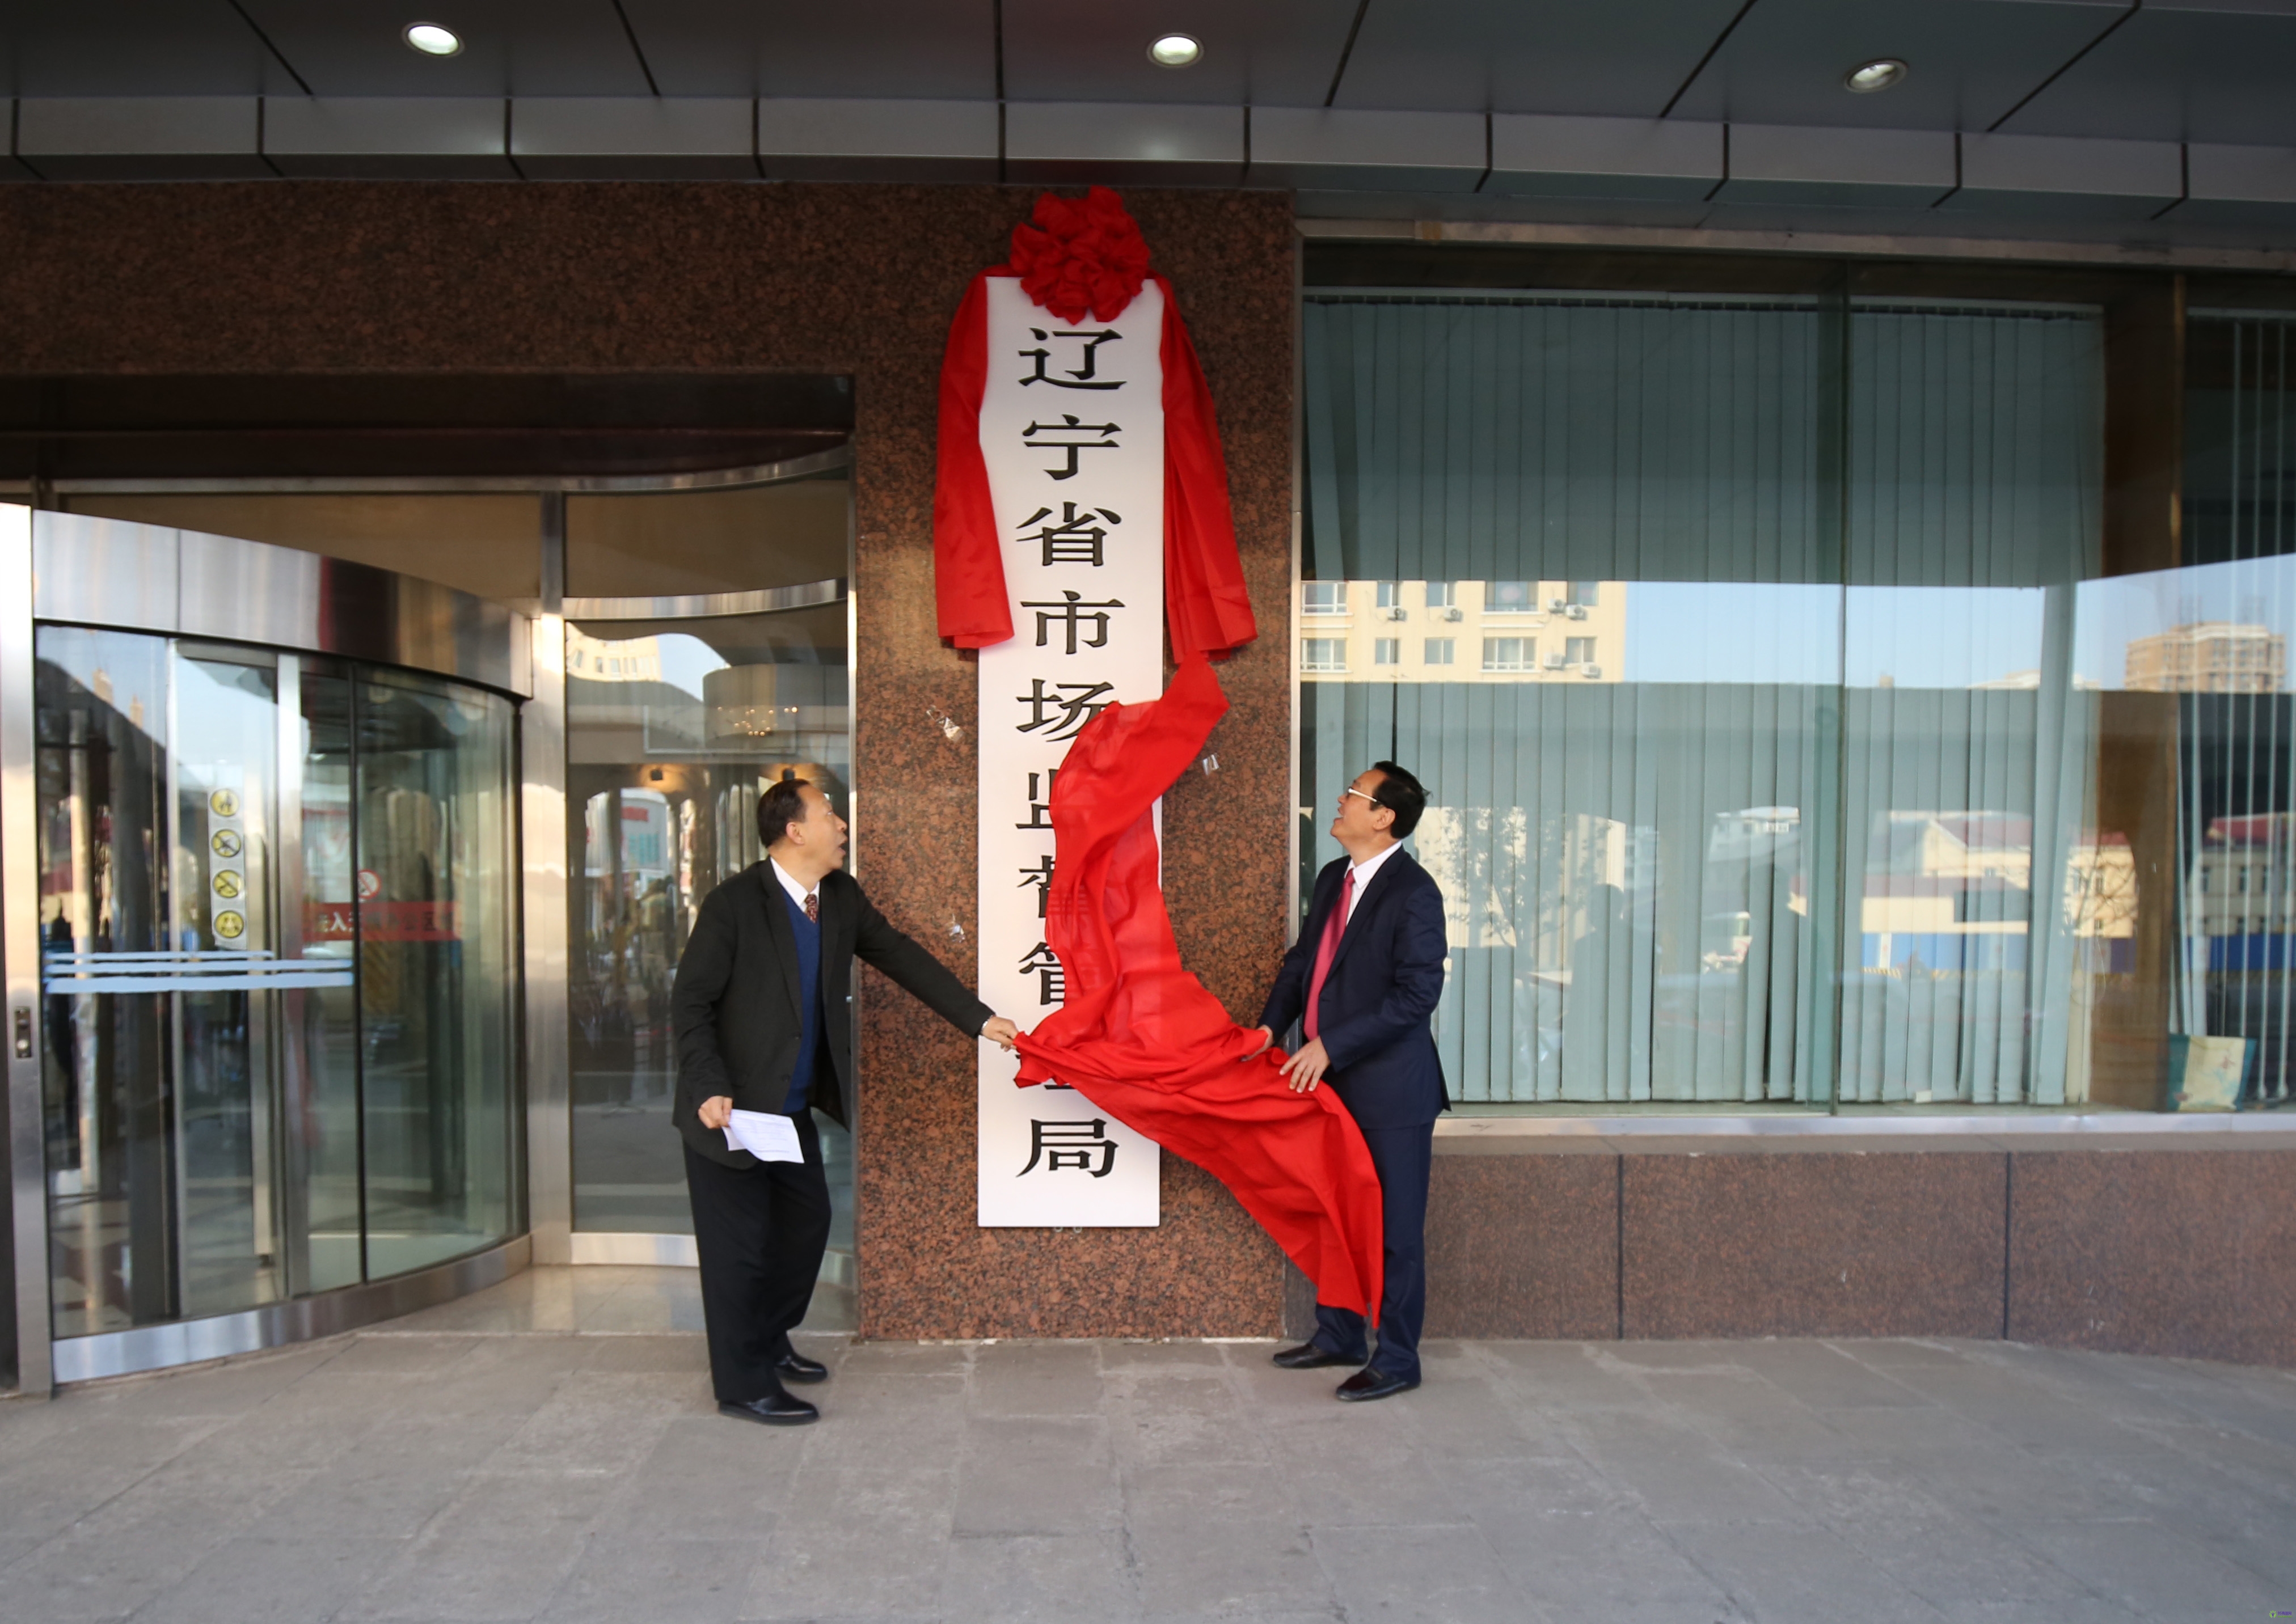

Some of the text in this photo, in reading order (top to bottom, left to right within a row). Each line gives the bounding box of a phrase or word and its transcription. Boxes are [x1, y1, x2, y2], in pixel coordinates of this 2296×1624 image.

[1015, 327, 1128, 1178] 辽宁省市场管局
